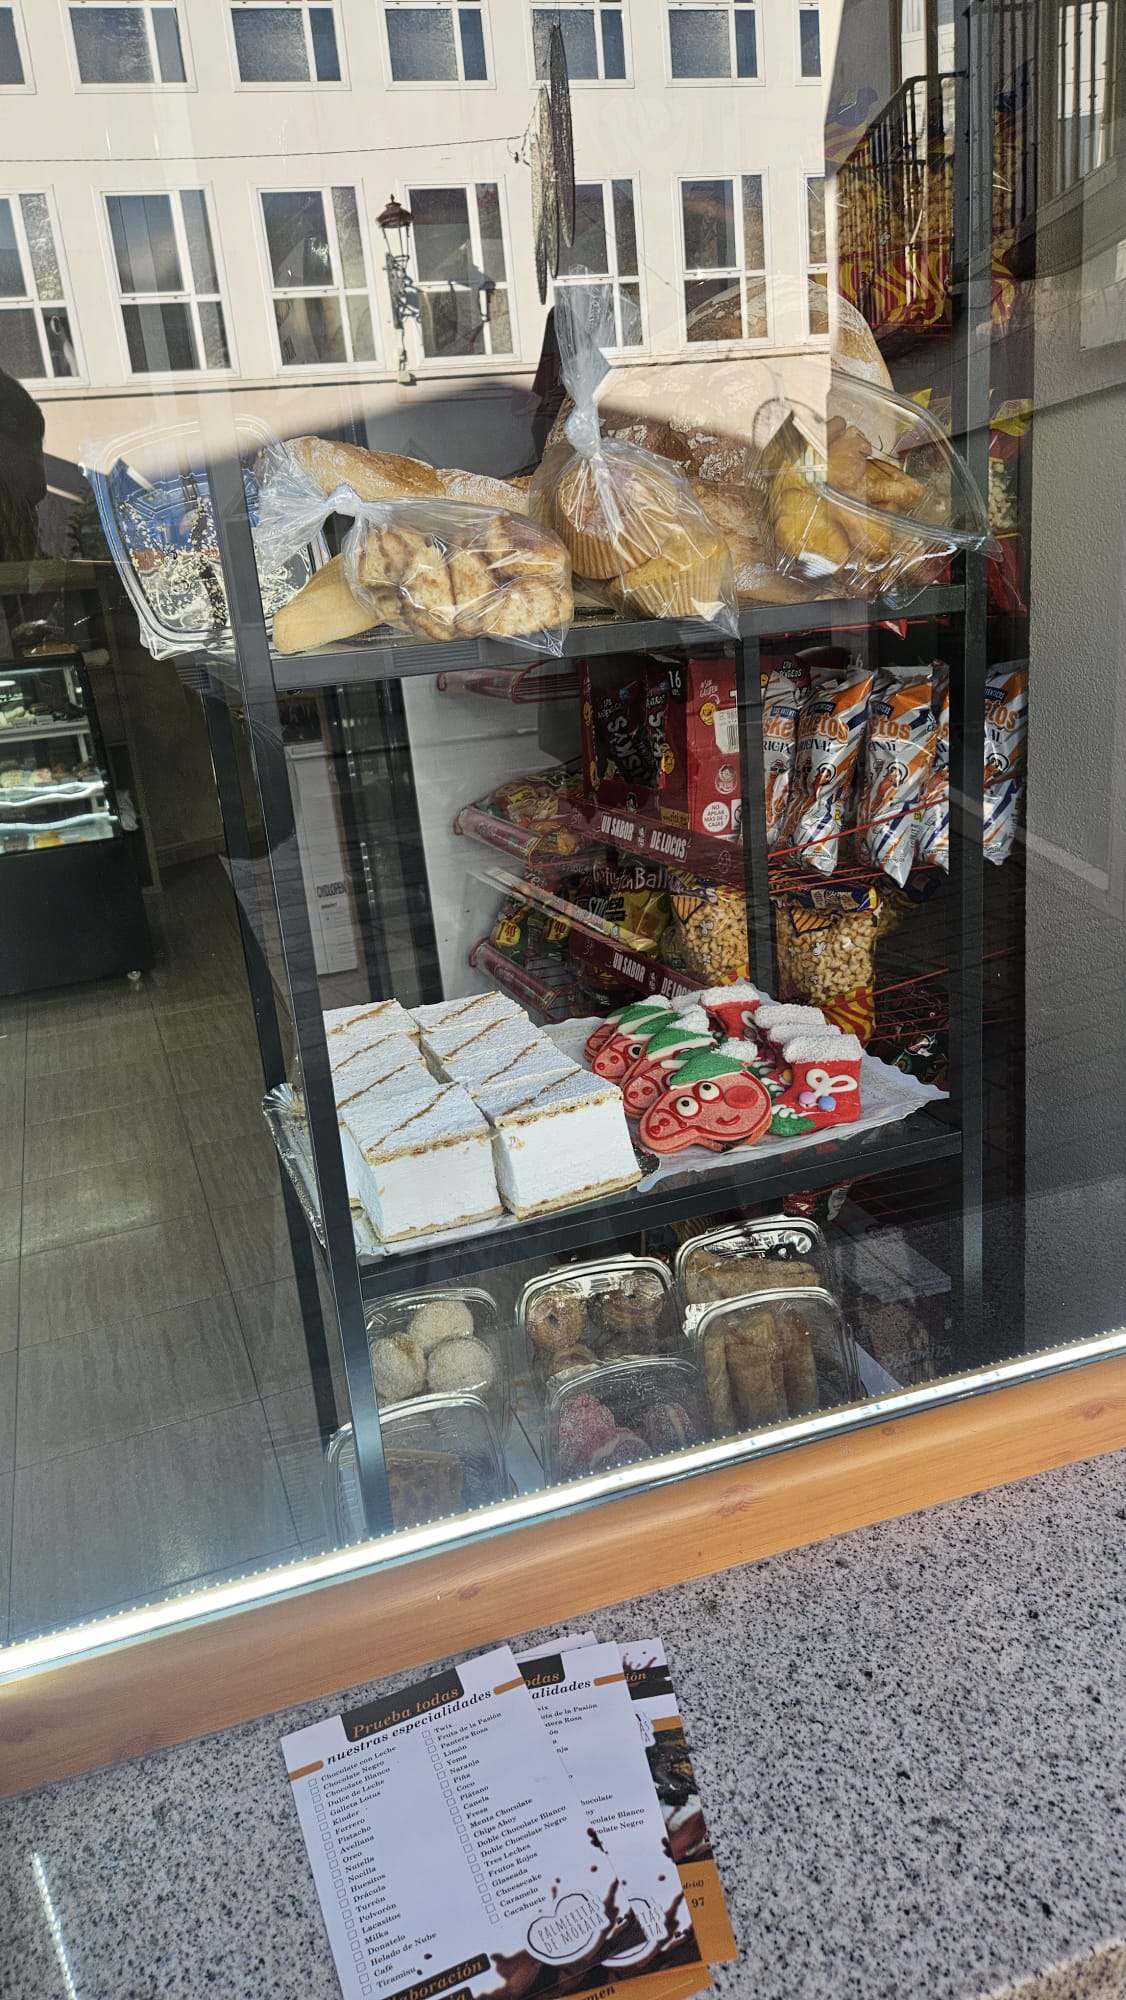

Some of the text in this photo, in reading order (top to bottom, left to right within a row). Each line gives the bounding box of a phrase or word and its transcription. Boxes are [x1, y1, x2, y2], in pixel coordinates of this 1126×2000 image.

[668, 670, 682, 688] 16
[601, 814, 687, 858] UN SABOR DE LOCOS
[613, 952, 624, 970] UN
[622, 956, 646, 984] SABOR
[661, 977, 673, 997] DE
[352, 1688, 459, 1740] Prueba todas
[574, 1704, 598, 1712] Pasión
[327, 1690, 492, 1764] nuestras especialidades
[434, 1724, 452, 1734] Twix
[438, 1712, 502, 1742] Fruta de la Pasión
[440, 1727, 488, 1749] Pantera Rosa
[444, 1744, 468, 1758] Limón
[446, 1754, 467, 1766] Yema
[321, 1746, 396, 1782] Chocolate con Leche
[450, 1760, 480, 1775] Naranja
[323, 1760, 384, 1790] Chocolate Negro
[326, 1768, 390, 1798] Chocolate Blanco
[453, 1772, 471, 1784] Piña
[327, 1778, 385, 1808] Dulce de Leche
[456, 1781, 476, 1792] Coco
[460, 1786, 489, 1800] Plátano
[330, 1790, 381, 1816] Galleta Lotus
[463, 1796, 490, 1810] Canela
[466, 1806, 488, 1820] Fresa
[470, 1798, 533, 1829] Menta Chocolate
[618, 1808, 644, 1818] Blanco
[332, 1810, 360, 1826] Kinder
[335, 1818, 366, 1835] Ferrero
[474, 1816, 517, 1838] Chips Ahoy
[476, 1805, 566, 1848] Doble Chocolate Blanco
[620, 1820, 644, 1829] Negro
[338, 1826, 372, 1844] Pistacho
[340, 1834, 374, 1854] Avellana
[480, 1816, 568, 1858] Doble Chocolate Negro
[342, 1851, 362, 1864] Oreo
[345, 1856, 374, 1874] Nutella
[484, 1844, 531, 1868] Tres Leches
[488, 1852, 538, 1878] Frutos Rojos
[348, 1866, 376, 1883] Nocilla
[350, 1874, 386, 1892] Huesitos
[492, 1867, 528, 1888] Glaseada
[354, 1884, 386, 1902] Drácula
[496, 1873, 542, 1898] Cheesecake
[356, 1896, 386, 1912] Turrón
[499, 1887, 539, 1908] Caramelo
[504, 1895, 546, 1918] Cacahuete
[692, 1897, 704, 1908] 97
[359, 1902, 396, 1923] Polvorón
[537, 1896, 602, 1942] PALMERITAS
[362, 1913, 401, 1934] Lacasitos
[544, 1914, 604, 1954] DE MORATA
[364, 1930, 389, 1944] Milka
[368, 1934, 406, 1955] Donatelo
[370, 1932, 437, 1966] Helado de Nube
[374, 1964, 394, 1978] Café
[376, 1967, 416, 1988] Tiramisu
